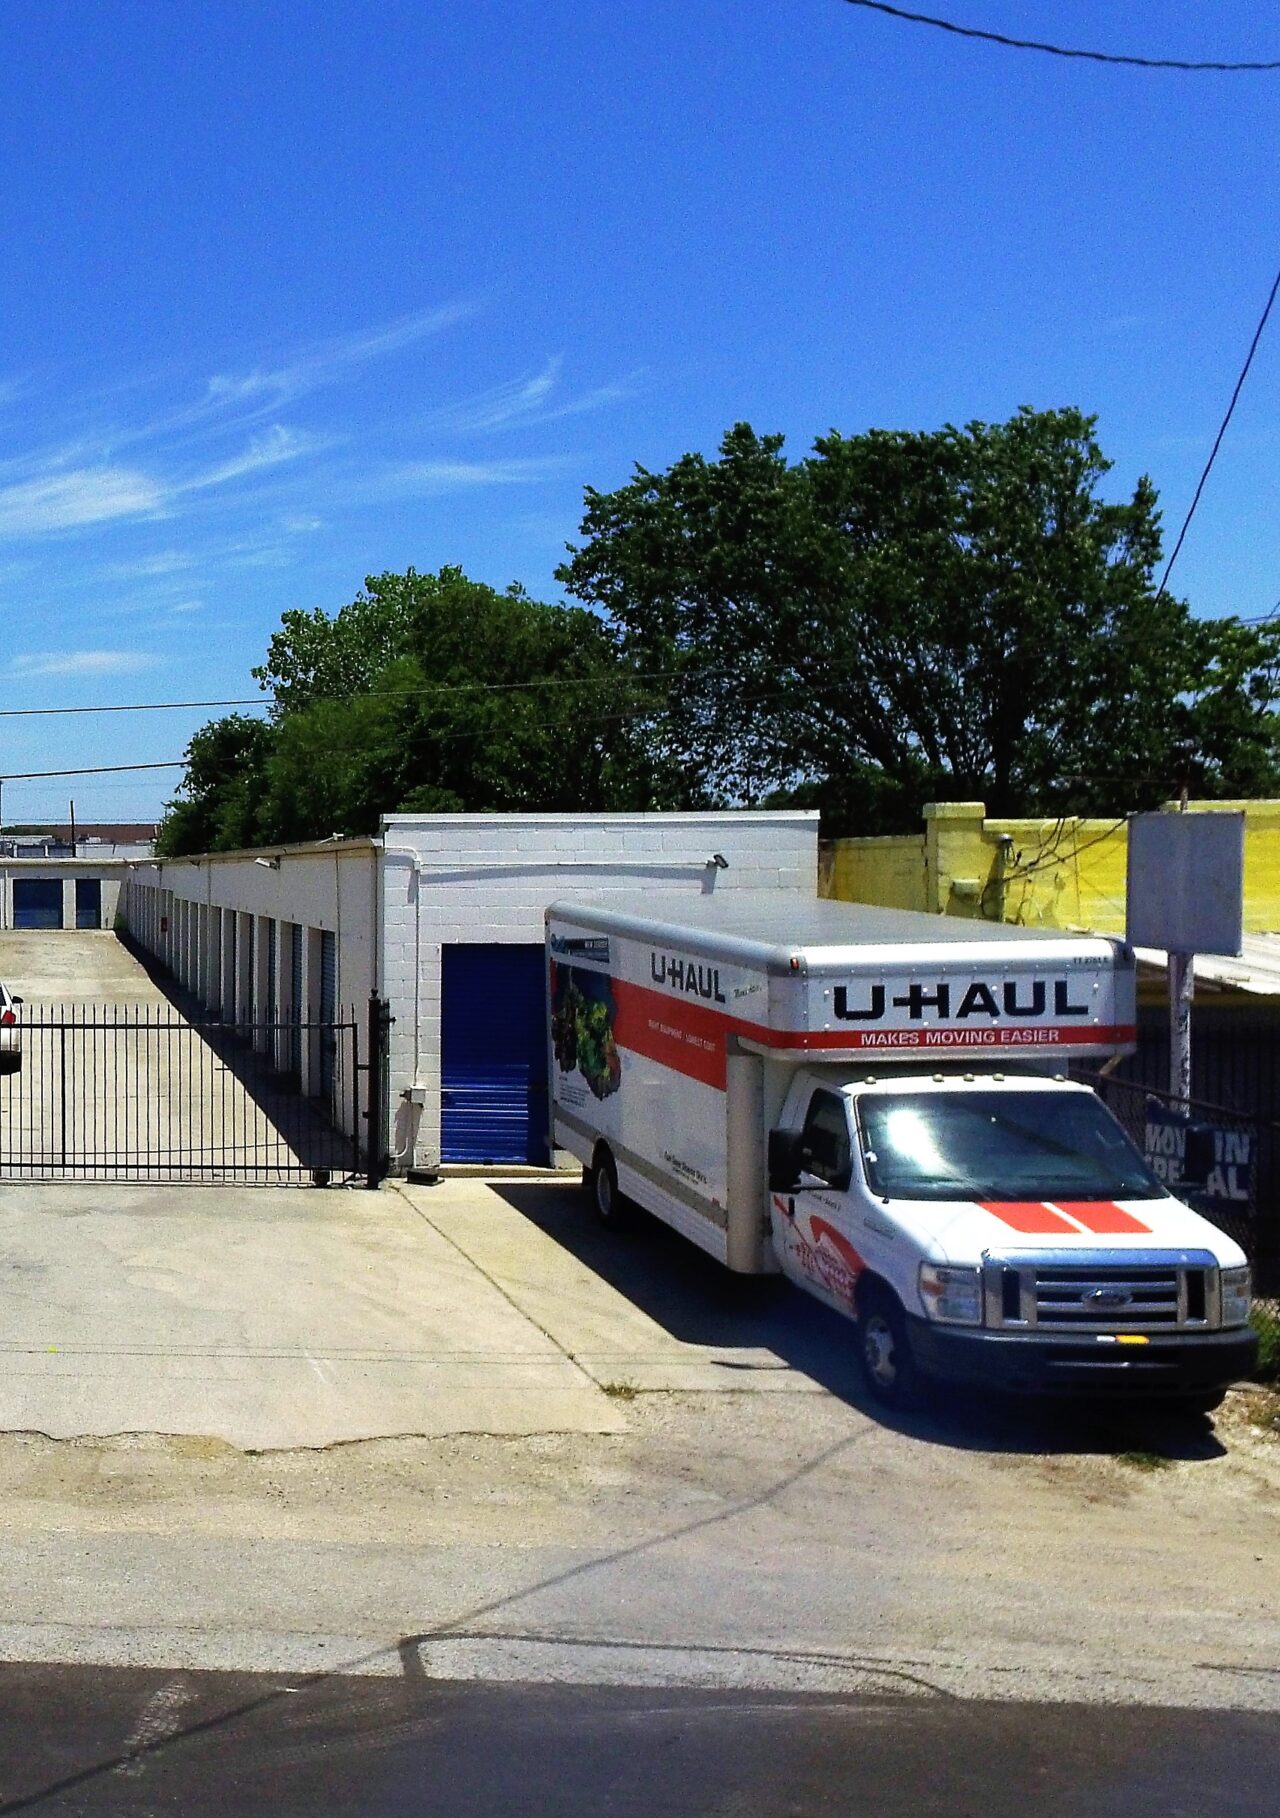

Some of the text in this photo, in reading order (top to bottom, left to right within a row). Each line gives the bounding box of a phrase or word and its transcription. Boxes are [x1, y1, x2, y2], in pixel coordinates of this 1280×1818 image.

[651, 952, 726, 1003] U-HAUL
[833, 980, 1089, 1020] U-HAUL
[861, 1029, 1060, 1046] MAKES MOVING EASIER
[1214, 1130, 1250, 1164] IN
